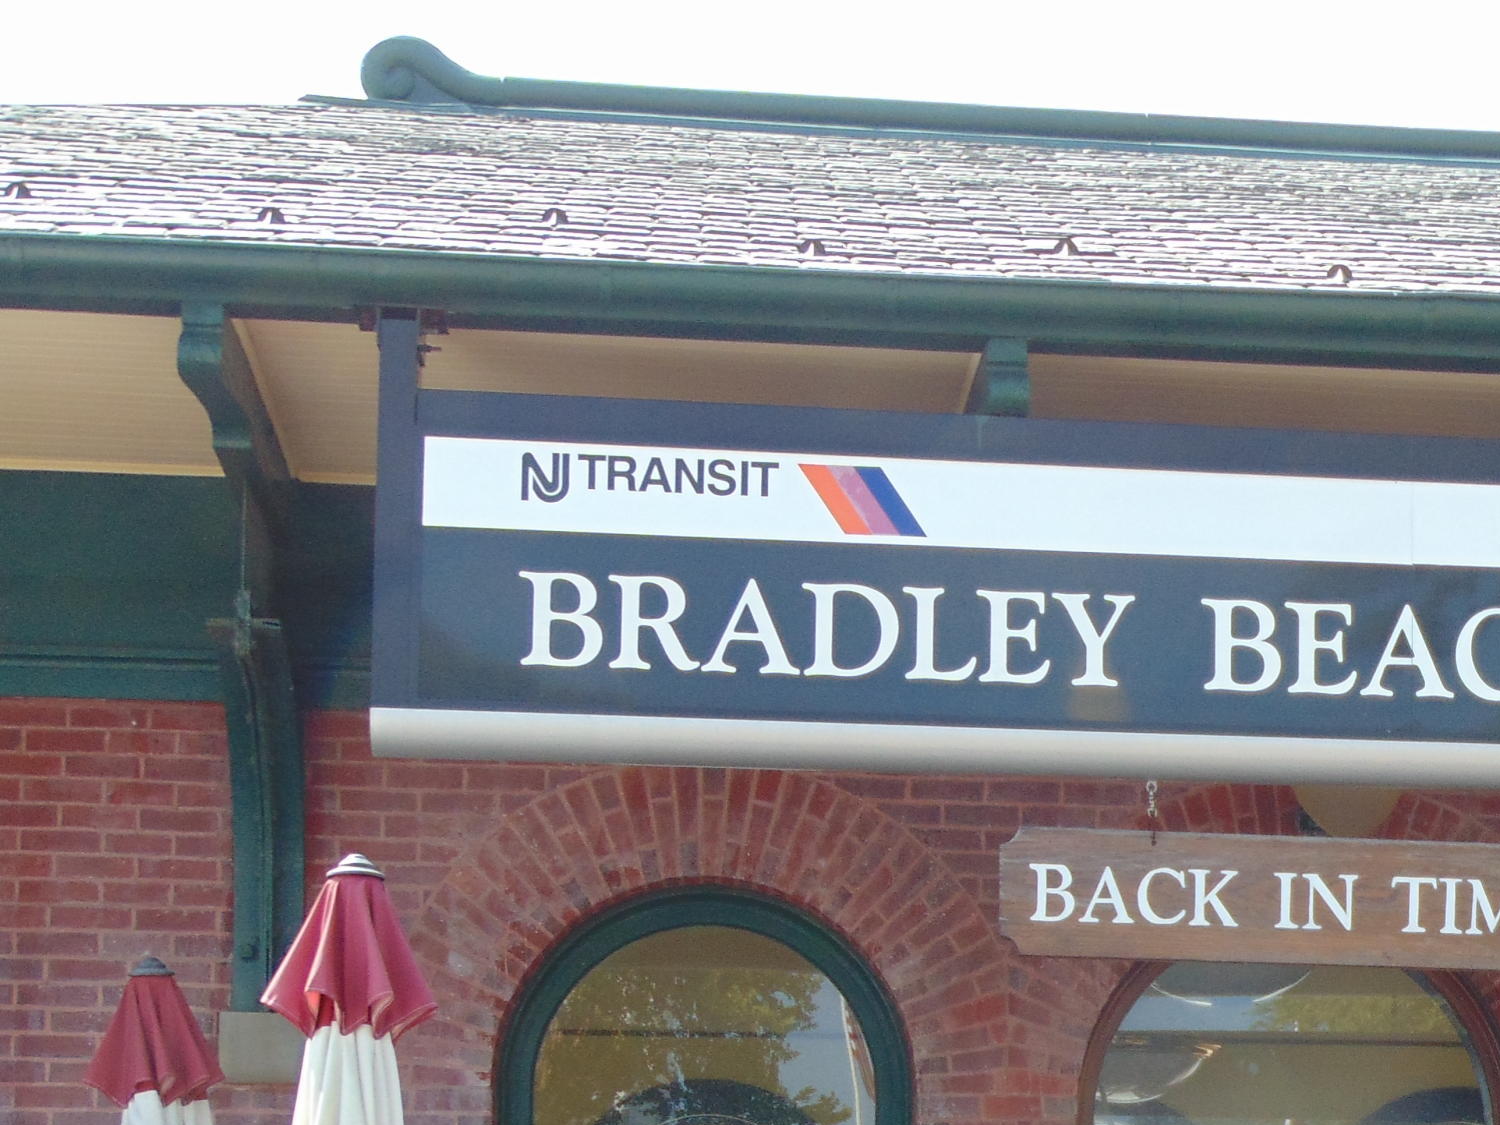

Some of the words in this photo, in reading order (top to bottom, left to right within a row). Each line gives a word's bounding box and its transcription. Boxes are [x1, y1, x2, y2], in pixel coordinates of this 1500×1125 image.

[521, 452, 570, 503] NJ
[578, 454, 780, 498] TRANSIT
[519, 570, 1137, 689] BRADLEY
[1029, 863, 1239, 928] BACK
[1274, 872, 1359, 931] IN
